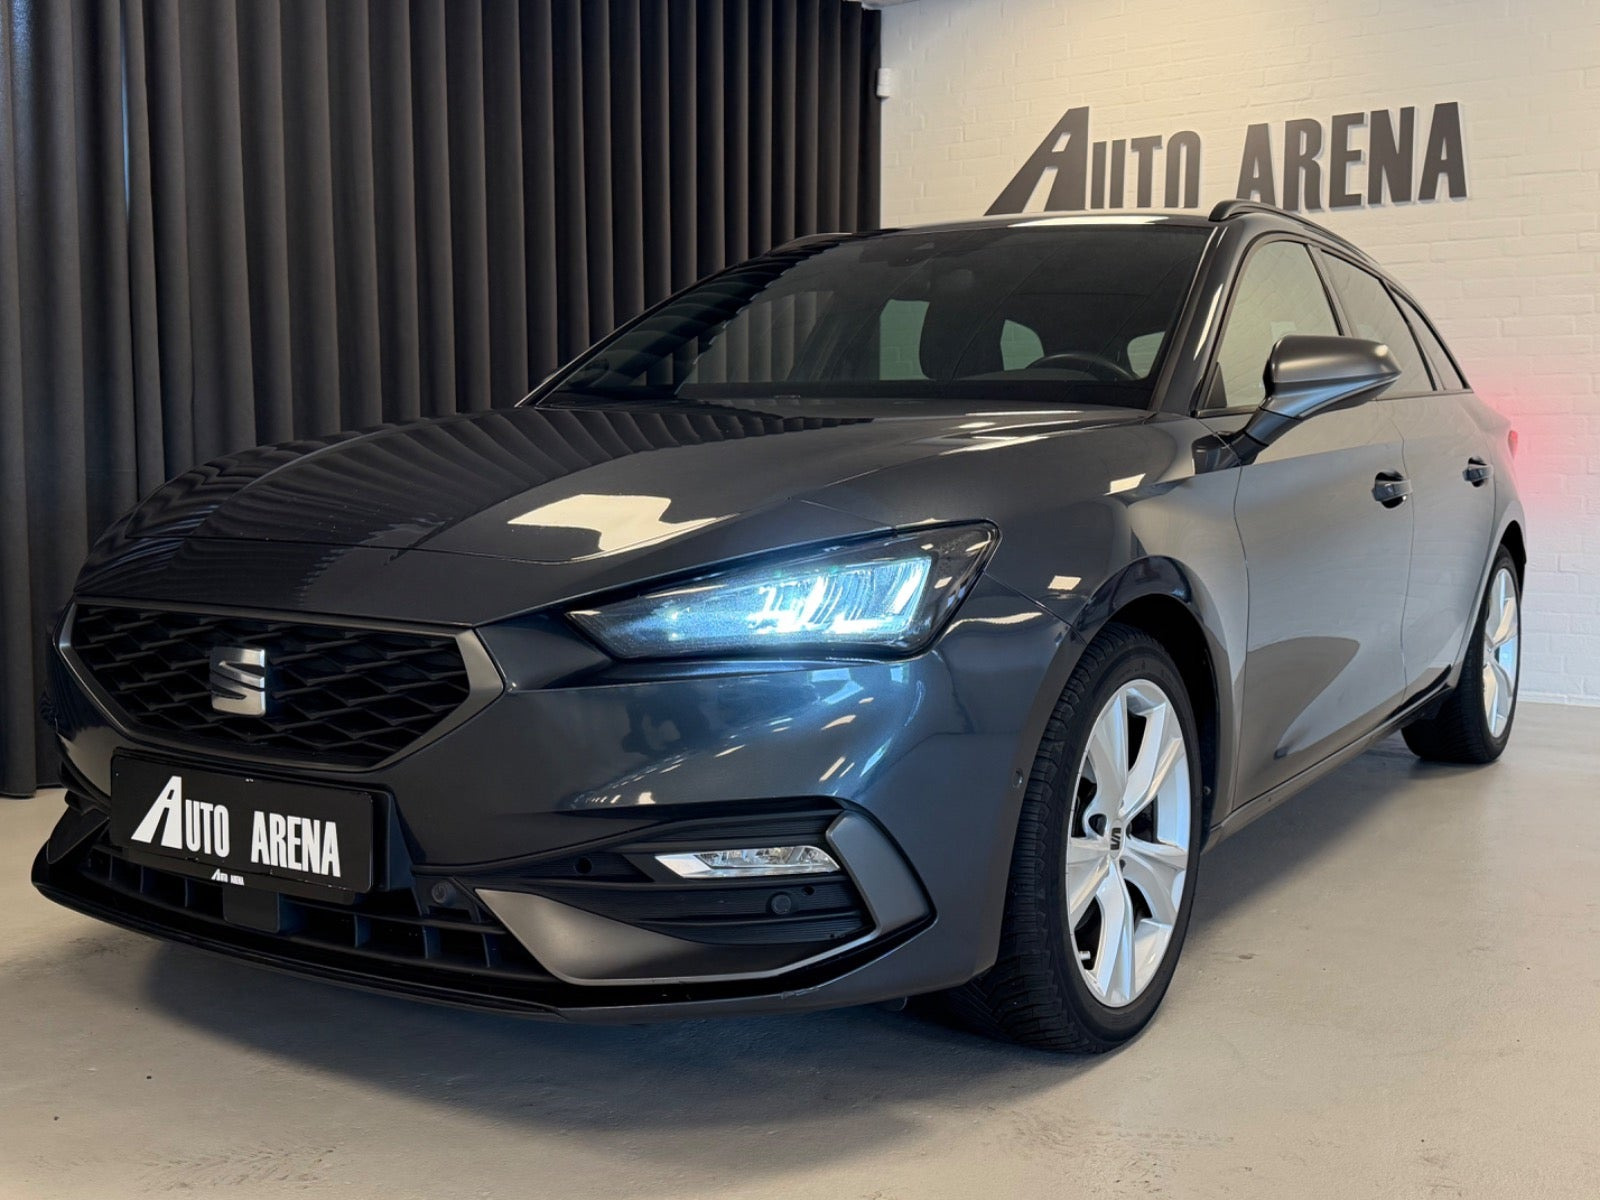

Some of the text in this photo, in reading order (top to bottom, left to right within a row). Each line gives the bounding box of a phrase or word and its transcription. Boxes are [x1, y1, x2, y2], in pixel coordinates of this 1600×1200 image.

[984, 101, 1467, 216] AUTO ARENA
[131, 775, 341, 878] AUTO ARENA
